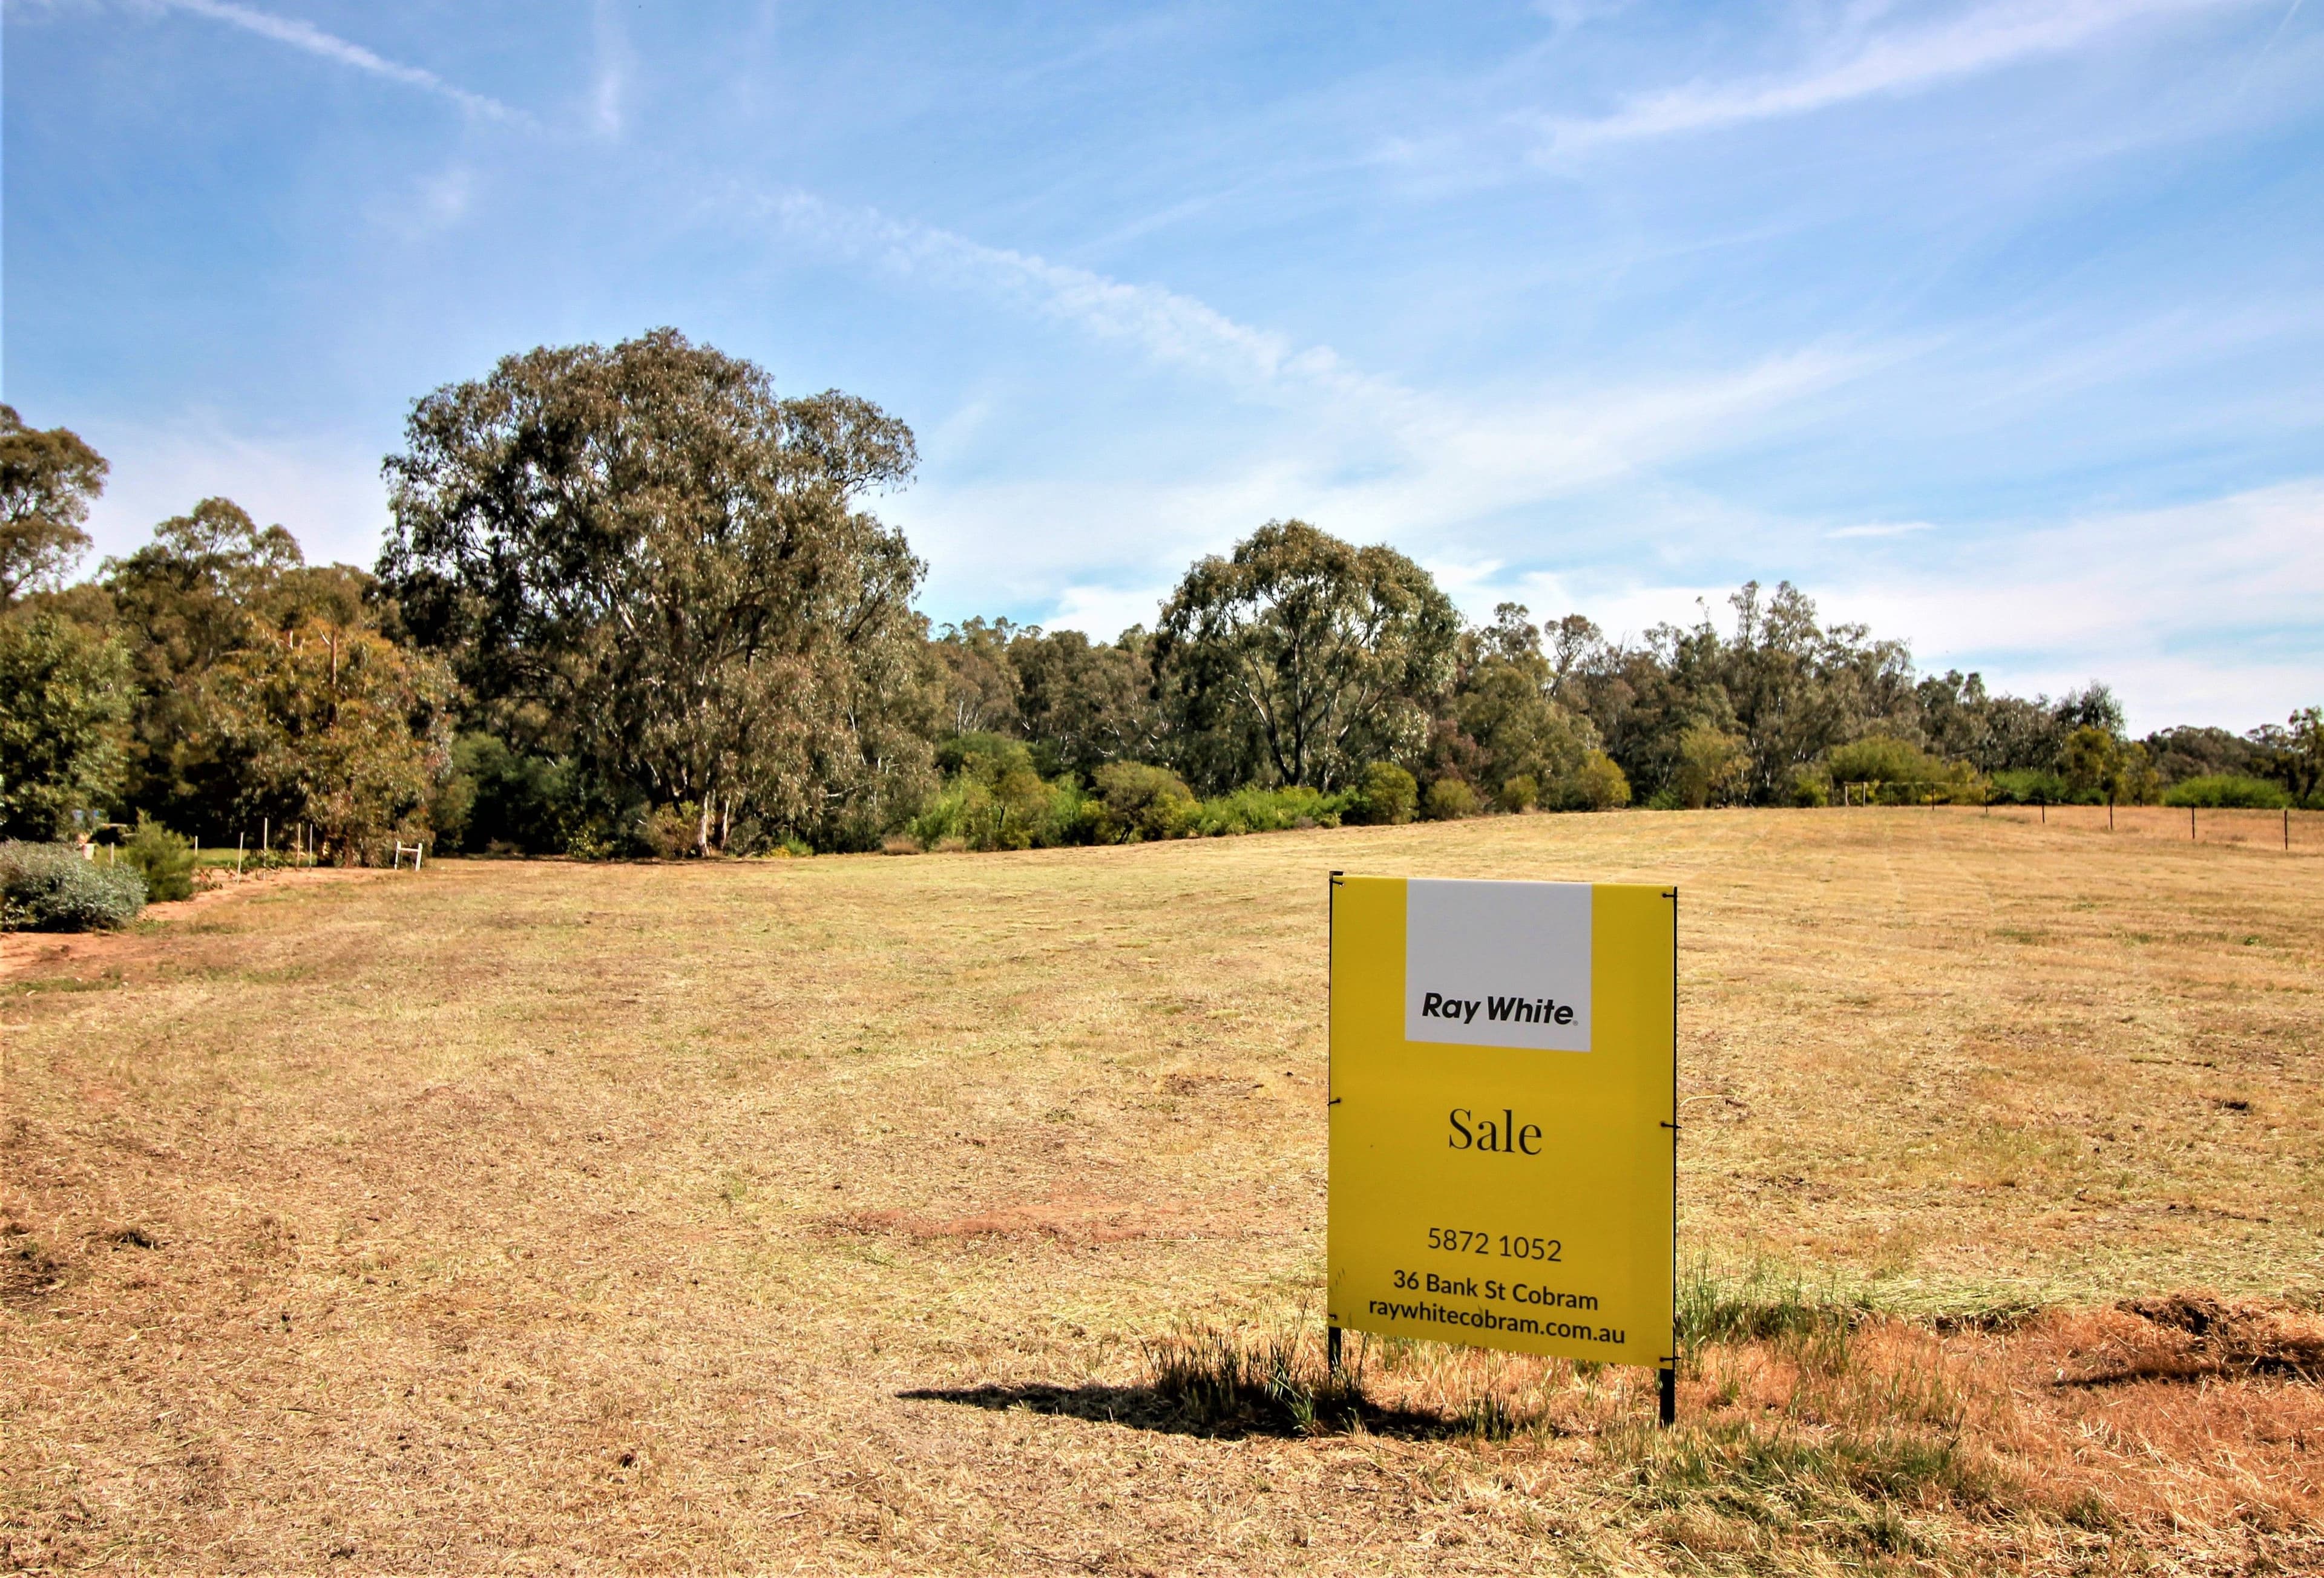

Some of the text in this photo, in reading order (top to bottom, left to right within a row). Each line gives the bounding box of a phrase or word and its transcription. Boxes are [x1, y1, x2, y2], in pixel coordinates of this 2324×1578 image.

[1422, 992, 1574, 1026] Ray White
[1449, 1108, 1543, 1156] Sale
[1428, 1227, 1563, 1263] 5872 1052
[1393, 1269, 1599, 1311] 36 Bank St Cobram
[1368, 1299, 1626, 1344] raywhitecobram.com.au
